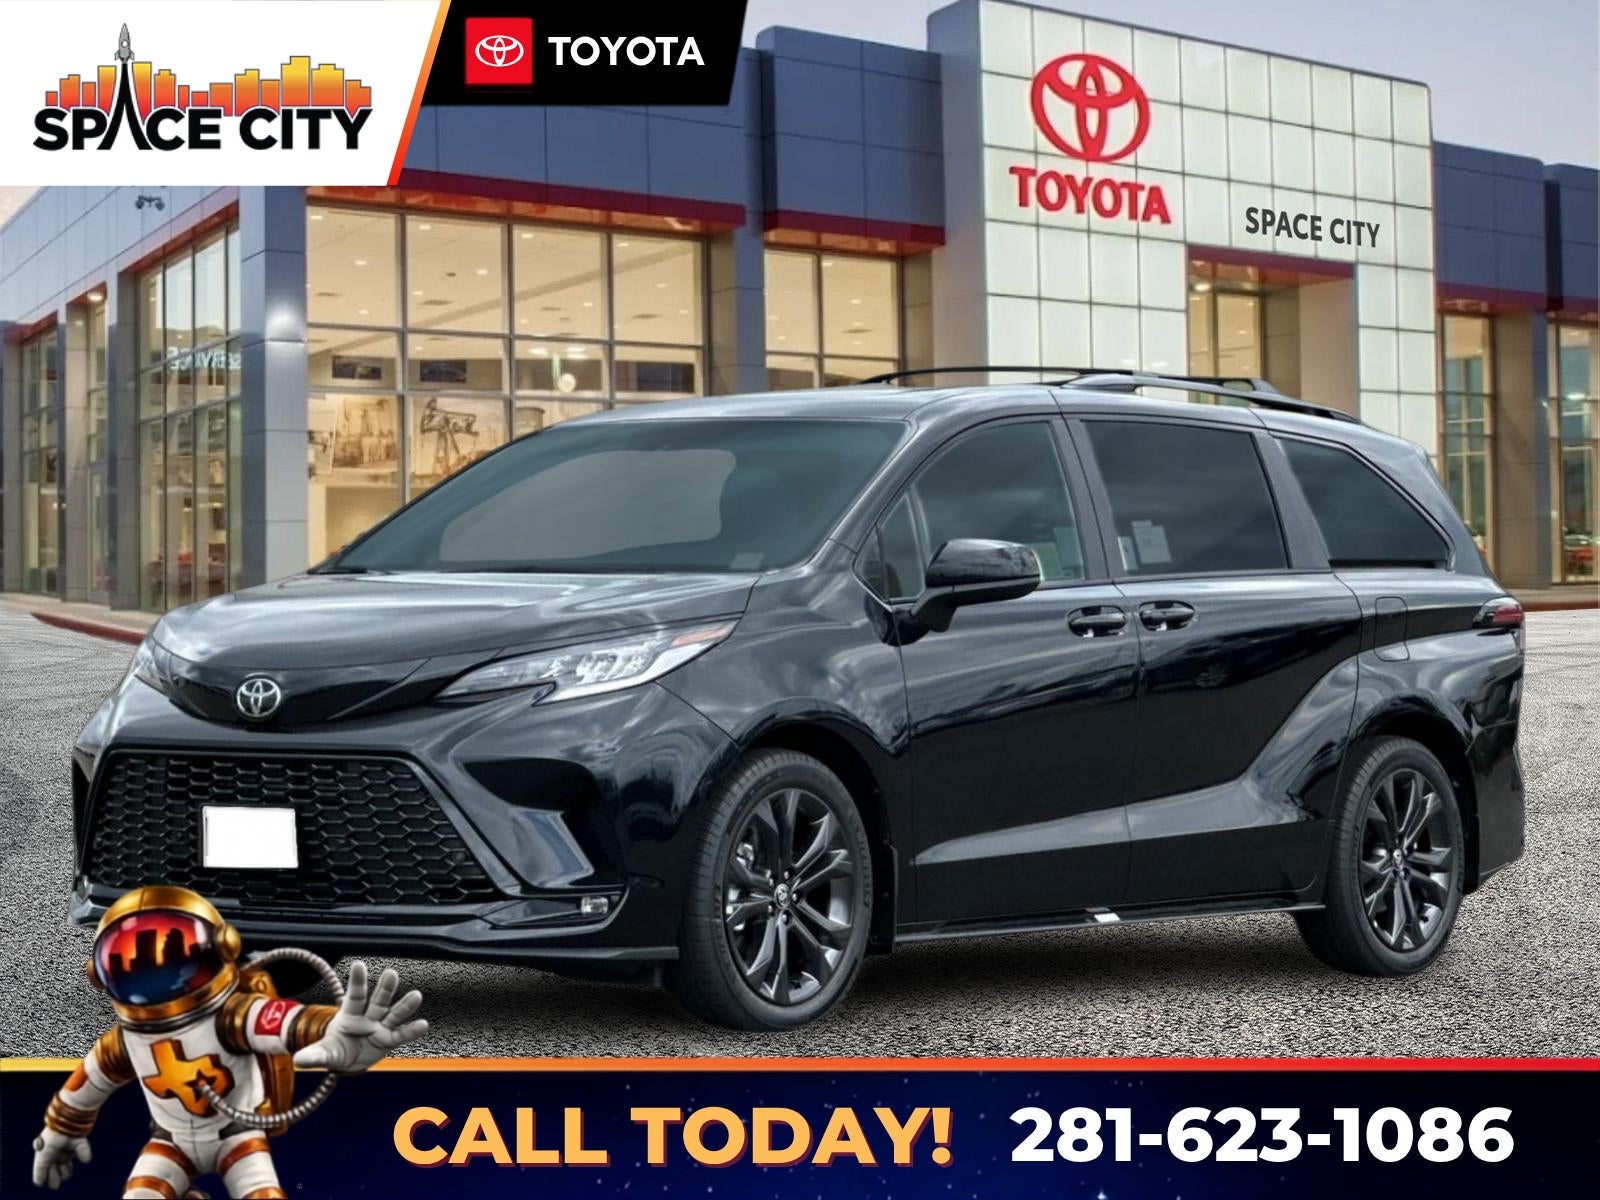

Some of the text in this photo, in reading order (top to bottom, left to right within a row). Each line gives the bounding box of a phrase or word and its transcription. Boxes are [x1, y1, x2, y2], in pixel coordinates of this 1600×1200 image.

[1008, 166, 1171, 224] TOYOTA
[1245, 206, 1381, 248] SPACE CITY
